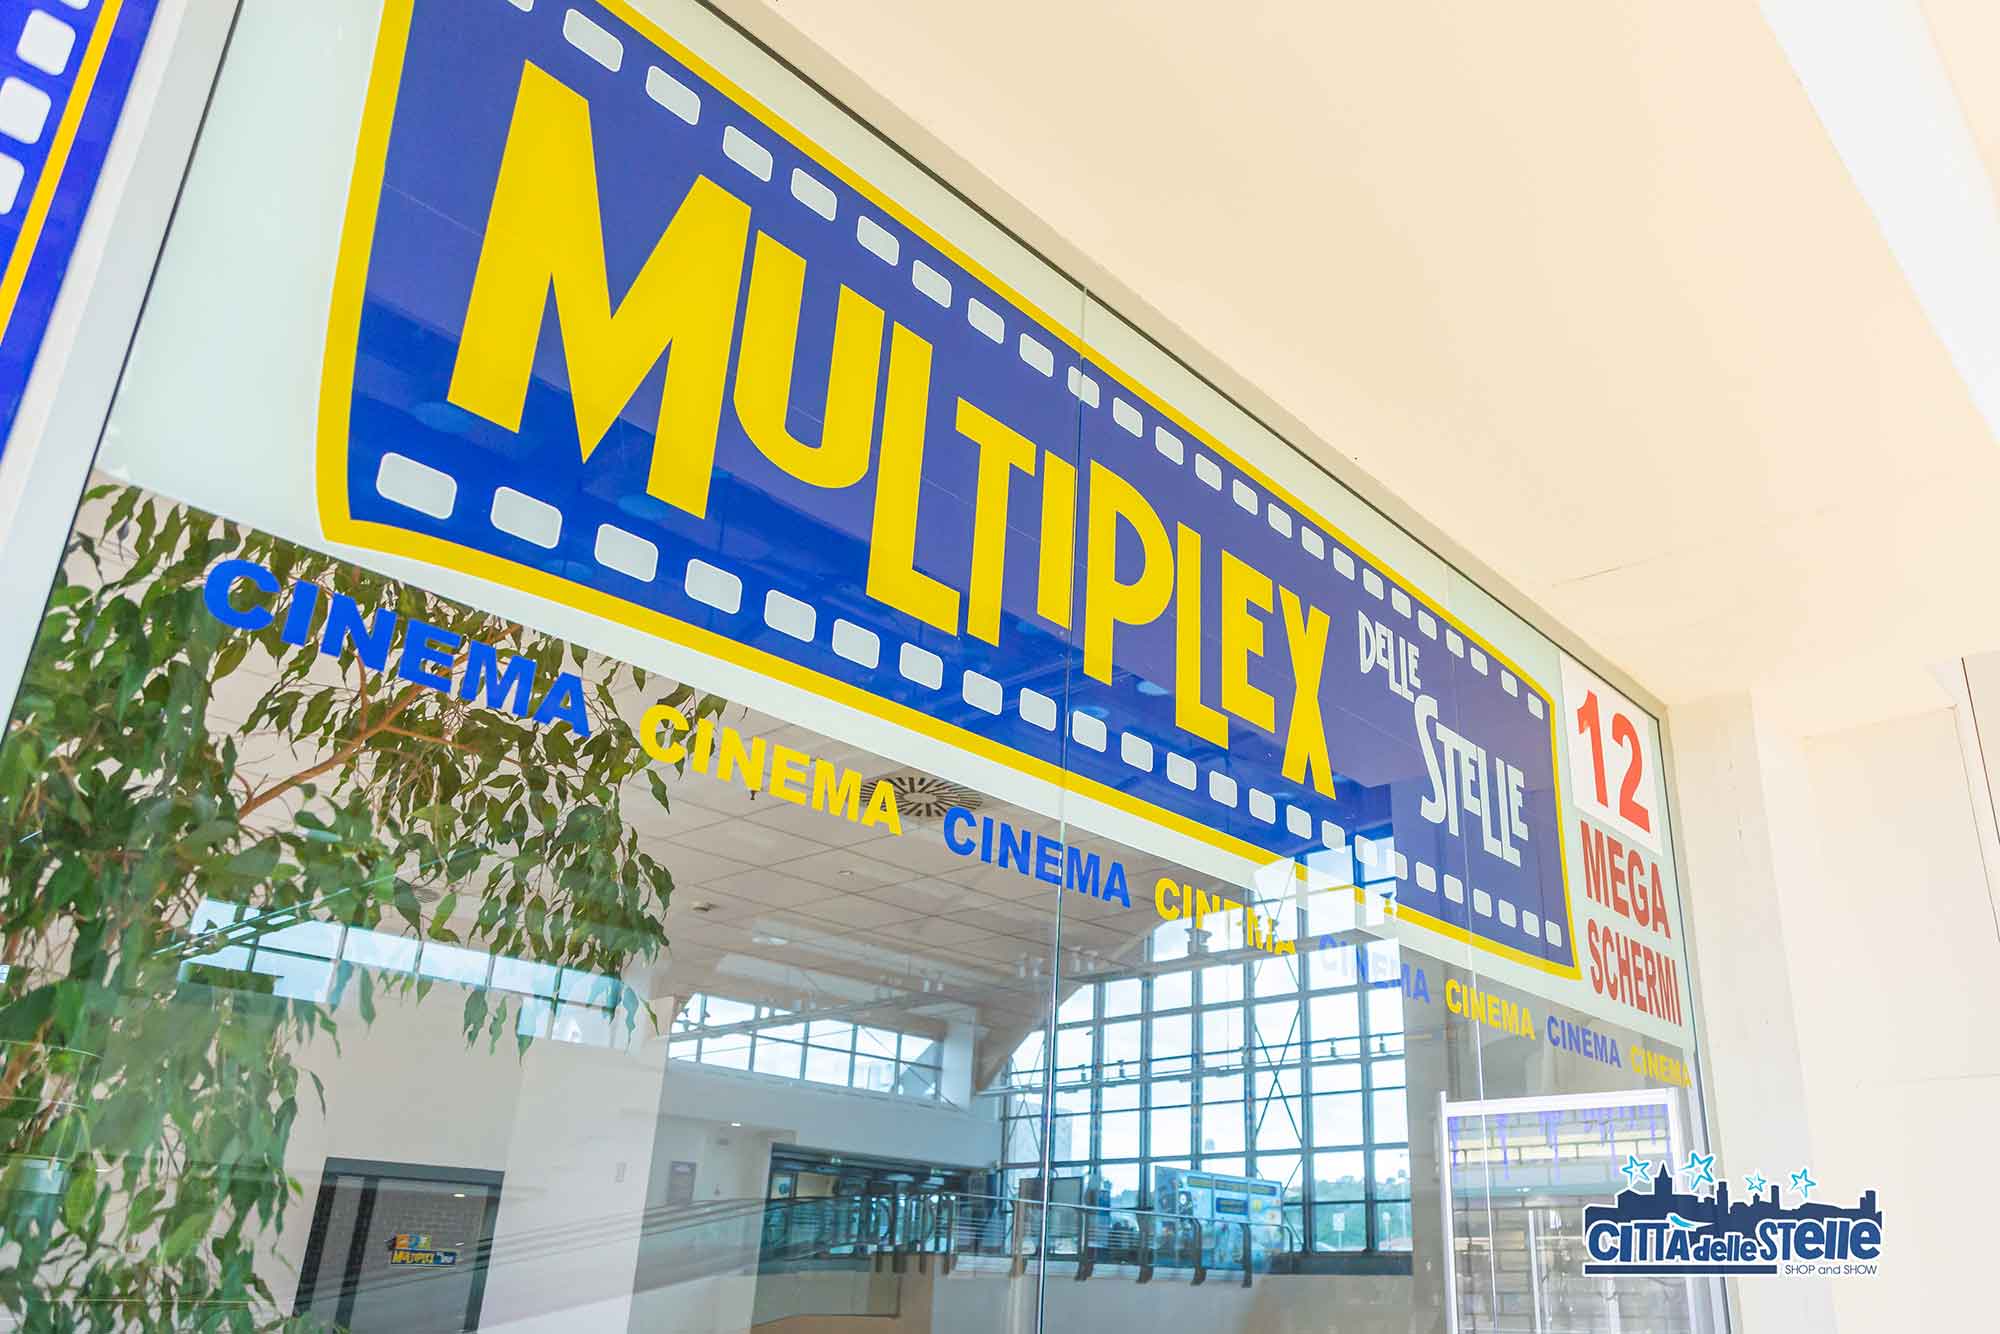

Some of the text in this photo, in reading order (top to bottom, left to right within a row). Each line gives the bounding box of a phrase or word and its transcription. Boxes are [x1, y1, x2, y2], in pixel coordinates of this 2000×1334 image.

[446, 60, 1336, 799] MULTIPLEX
[1358, 610, 1421, 702] DELLE
[204, 559, 591, 738] CINEMA
[639, 704, 902, 836] CINEMA
[943, 806, 1131, 908] CINEMA
[1445, 978, 1536, 1040] CINEMA
[1546, 1015, 1622, 1068] CINEMA
[1630, 1044, 1692, 1088] CINEMA
[1414, 694, 1529, 867] STELLE
[1576, 689, 1651, 833] 12
[1580, 819, 1671, 939] MEGA
[1587, 918, 1683, 1027] SCHERMI
